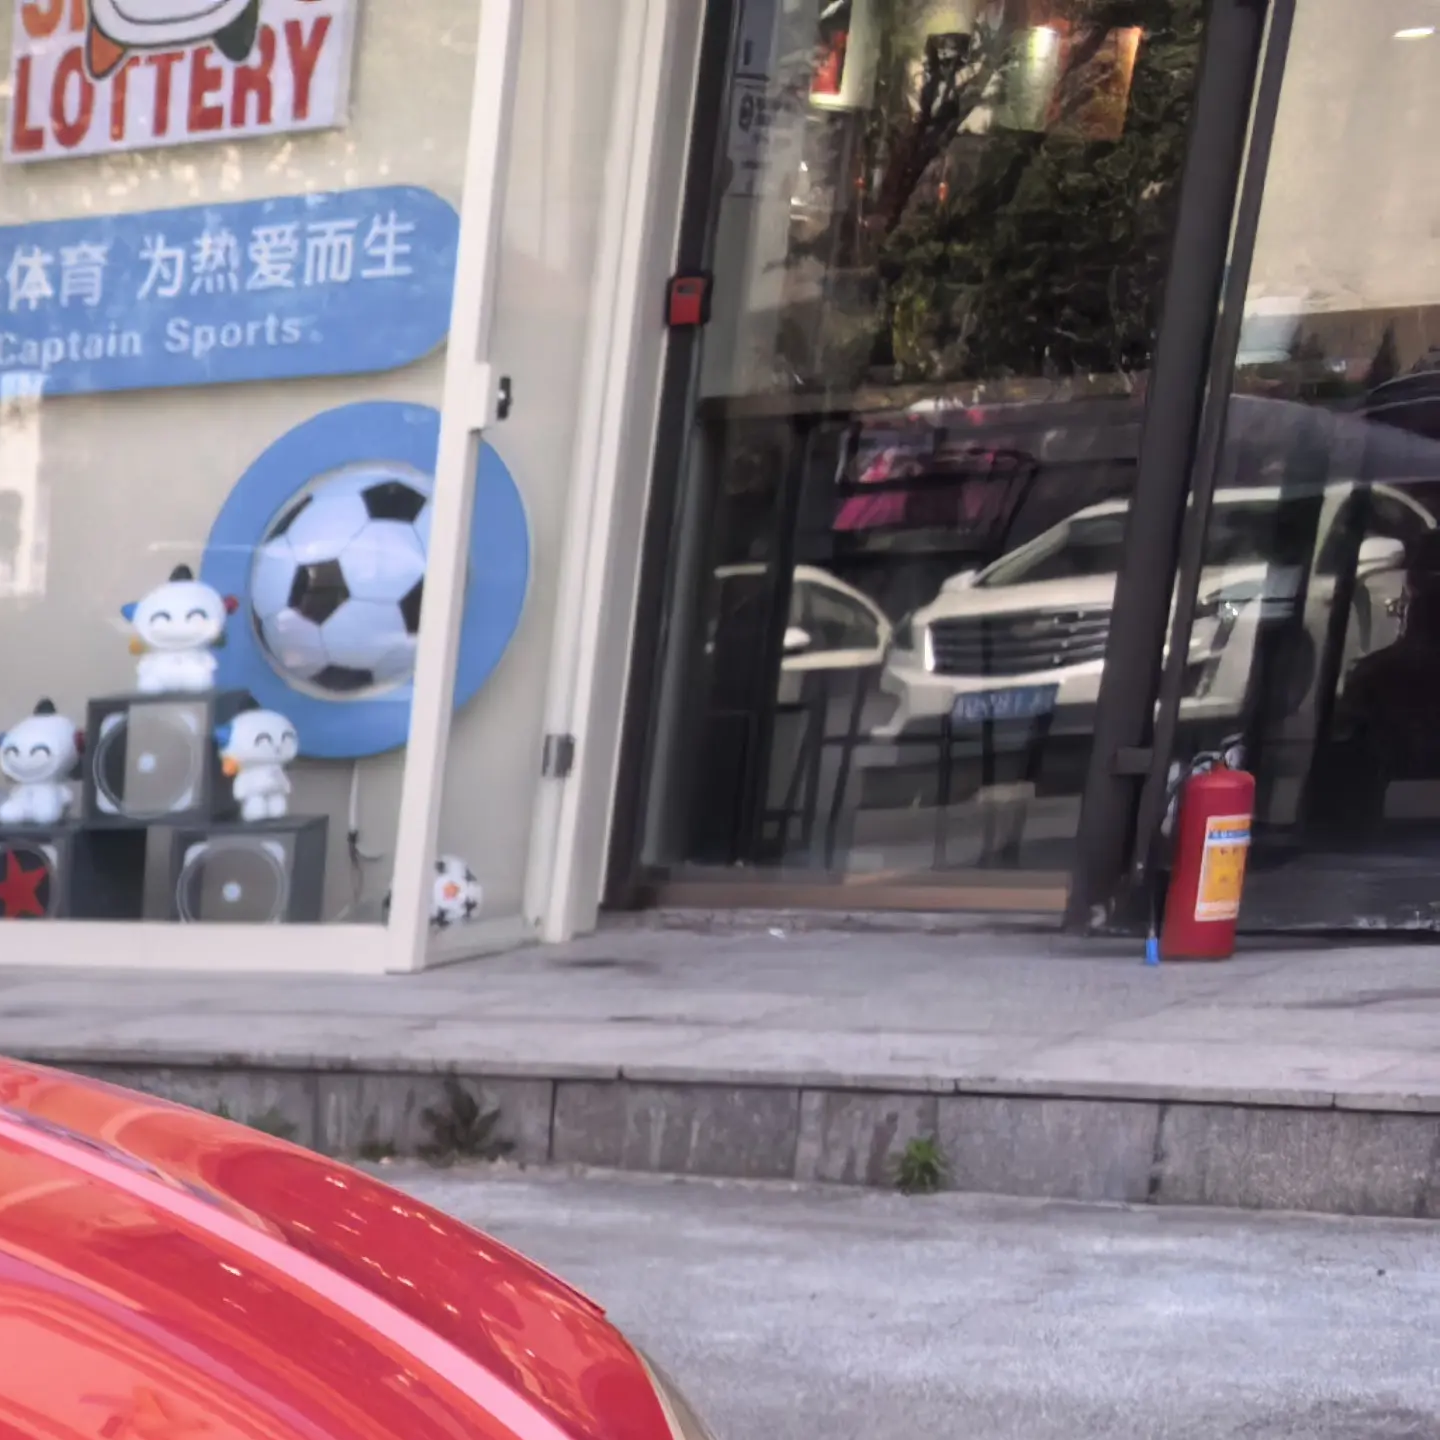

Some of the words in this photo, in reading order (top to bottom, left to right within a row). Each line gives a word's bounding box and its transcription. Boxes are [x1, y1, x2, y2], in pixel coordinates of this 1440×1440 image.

[11, 16, 332, 154] LOTTERY
[137, 211, 417, 300] 为热爱而生
[165, 314, 302, 358] Sports
